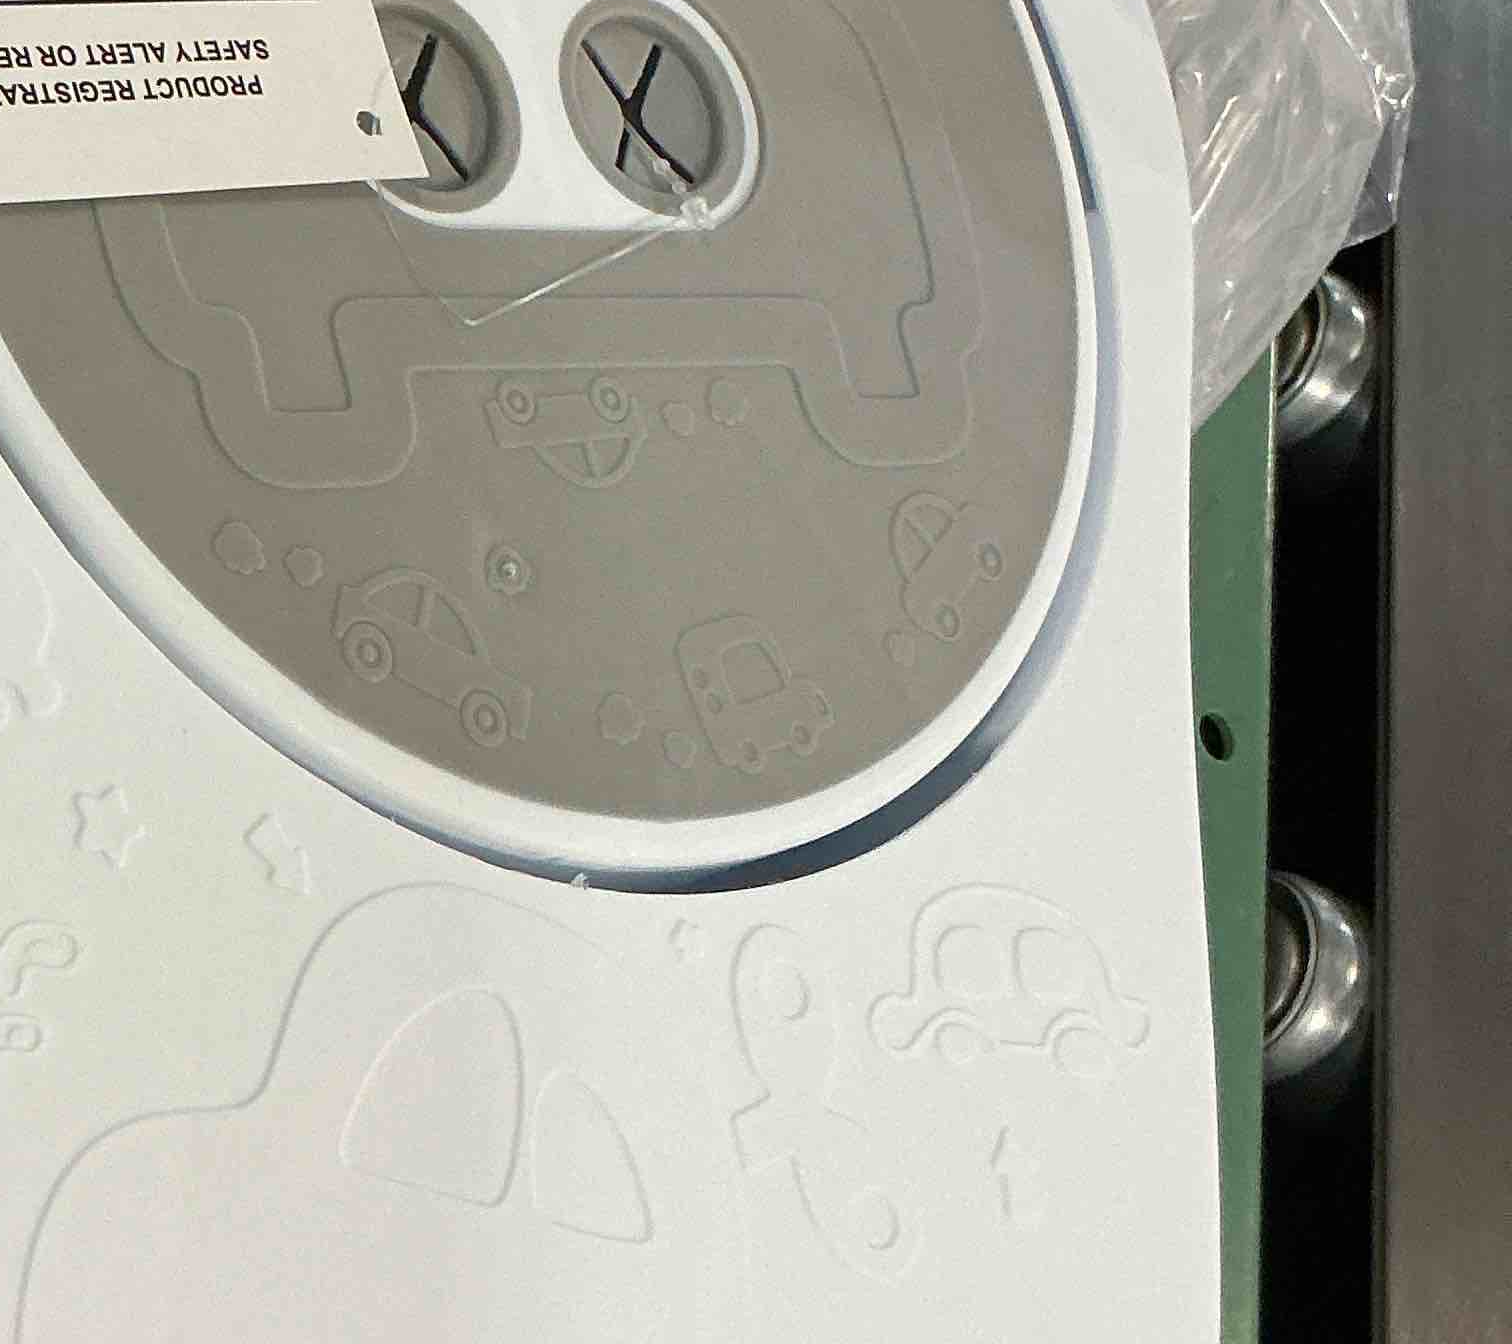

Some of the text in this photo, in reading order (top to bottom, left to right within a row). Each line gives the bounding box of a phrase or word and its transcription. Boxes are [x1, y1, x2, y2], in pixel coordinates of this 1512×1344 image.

[33, 44, 78, 68] OR
[84, 40, 166, 67] ALERT
[175, 38, 271, 65] SAFETY
[142, 73, 265, 101] PRODUCT
